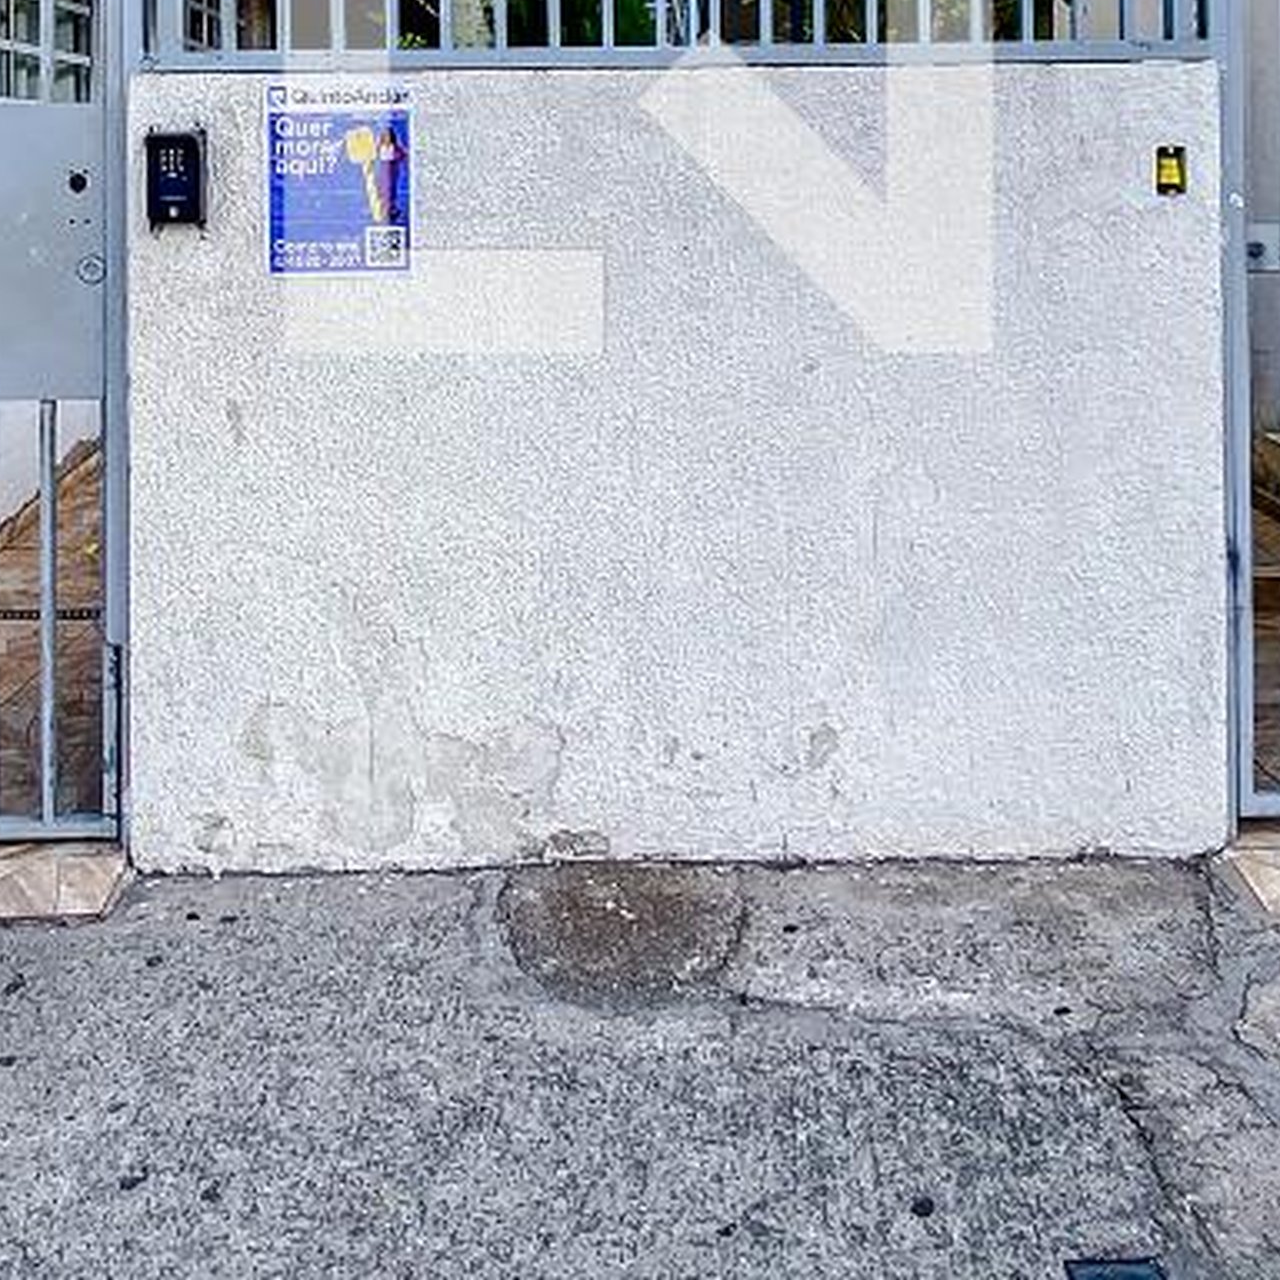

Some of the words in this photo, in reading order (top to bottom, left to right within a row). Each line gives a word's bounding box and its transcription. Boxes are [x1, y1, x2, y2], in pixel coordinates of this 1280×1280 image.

[275, 116, 335, 138] Quer
[275, 139, 345, 155] morar
[275, 156, 338, 180] aqui?
